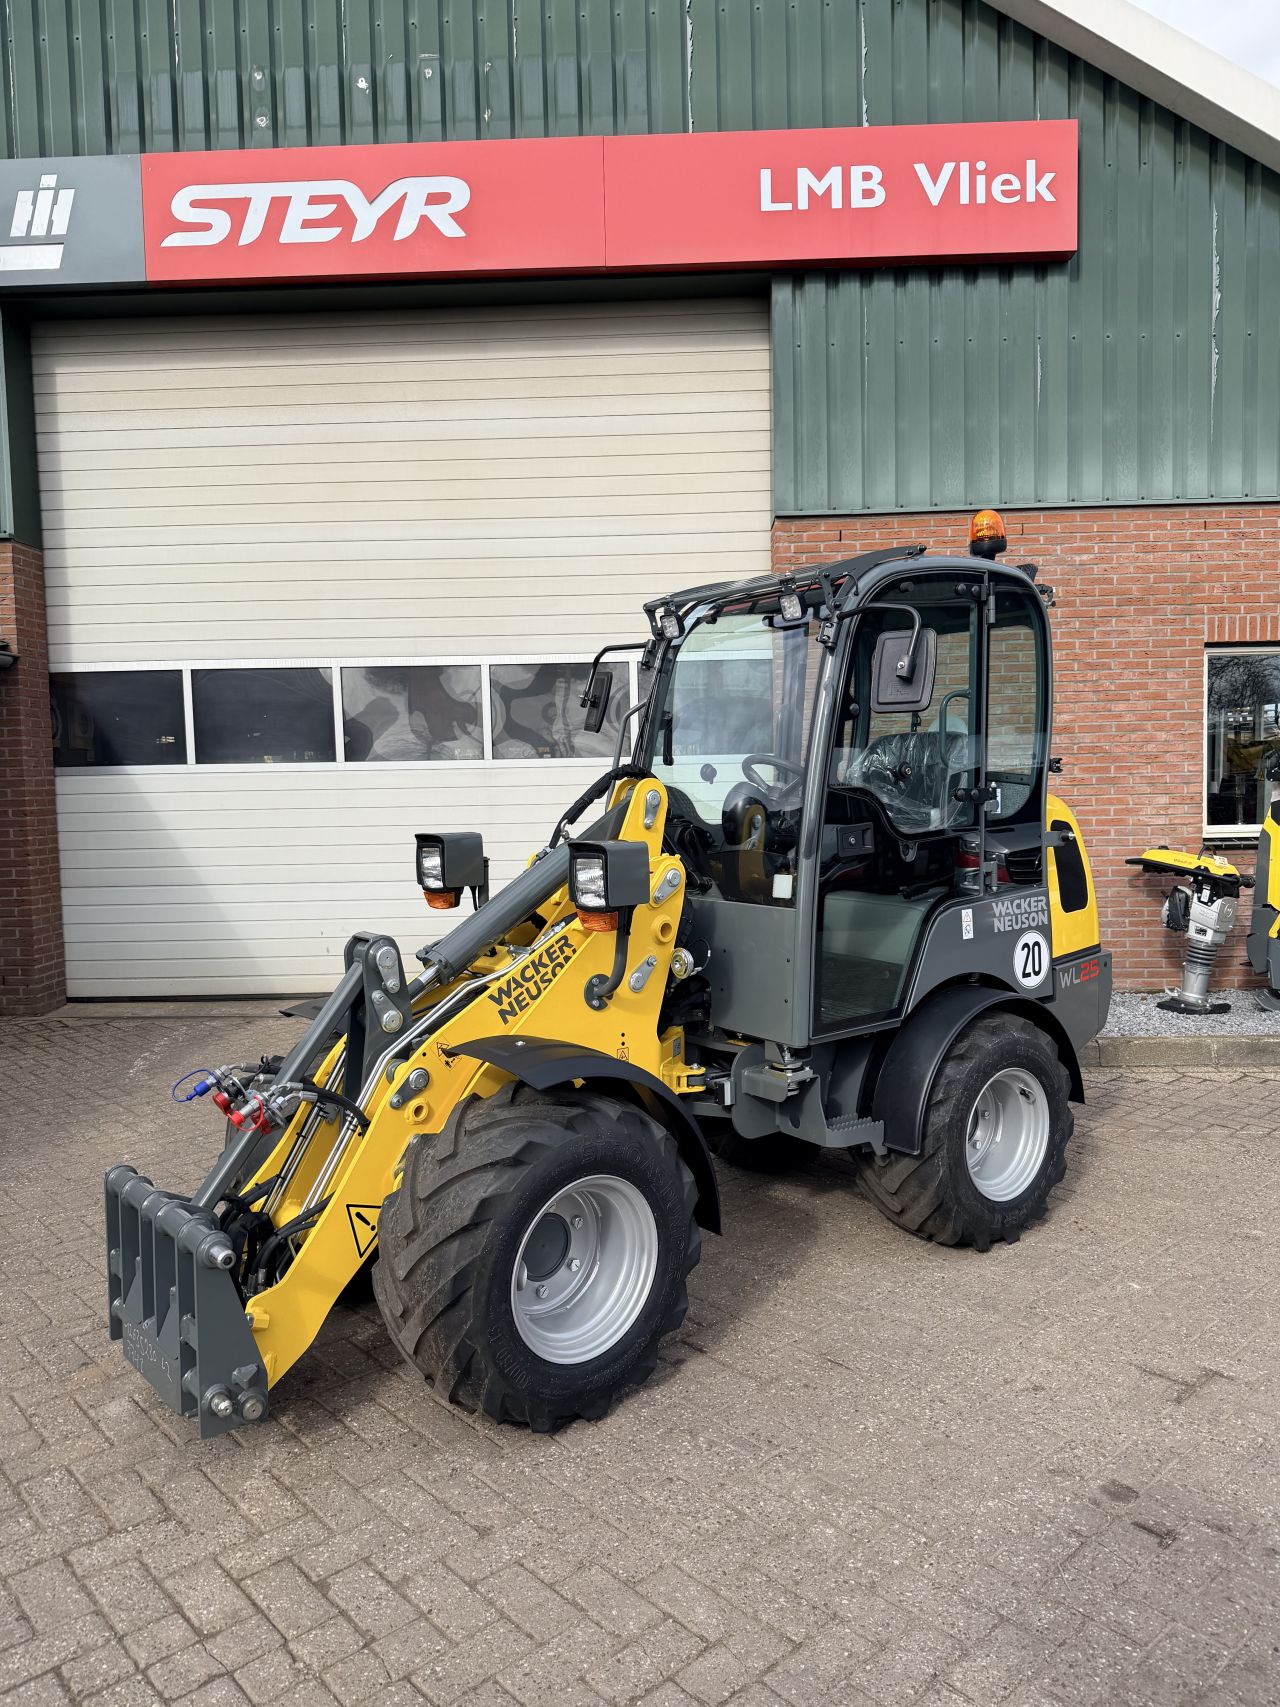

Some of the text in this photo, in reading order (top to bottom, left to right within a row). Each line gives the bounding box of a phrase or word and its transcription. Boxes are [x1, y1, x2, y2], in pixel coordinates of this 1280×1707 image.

[760, 159, 1057, 211] LMB Vliek
[160, 176, 471, 247] STEYR
[992, 896, 1047, 916] WACKER
[994, 911, 1048, 932] NEUSON
[488, 935, 574, 1006] WACKER
[1020, 940, 1042, 979] 20
[1060, 959, 1099, 989] WL25
